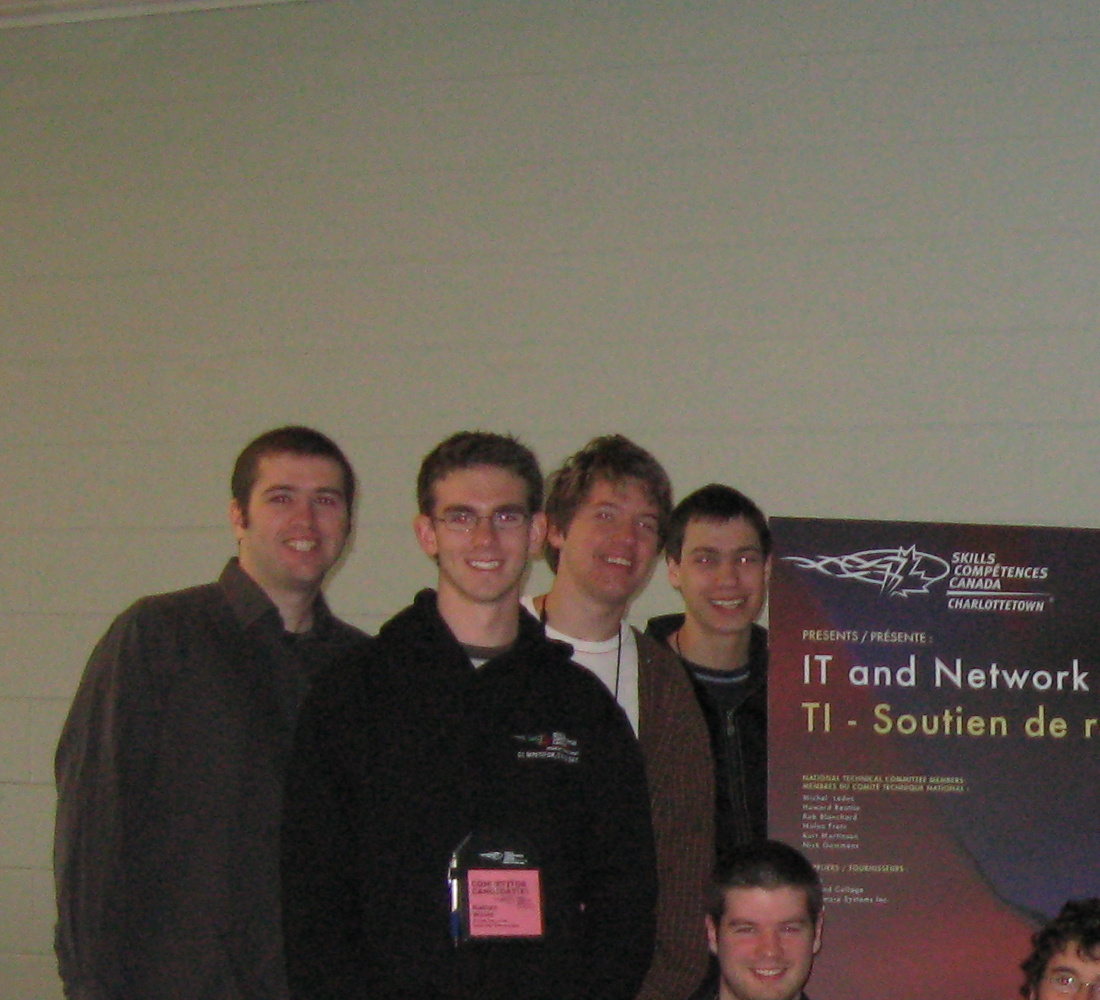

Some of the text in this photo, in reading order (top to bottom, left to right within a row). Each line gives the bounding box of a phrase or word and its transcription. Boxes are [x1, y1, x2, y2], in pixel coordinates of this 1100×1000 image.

[951, 552, 996, 564] SKILLS
[954, 563, 1048, 579] COMPÉTENCES
[949, 578, 1001, 590] CANADA
[947, 598, 1045, 612] CHARLOTTETOWN
[802, 629, 858, 641] PRESENTS
[870, 629, 926, 643] PRÉSENTE
[803, 654, 833, 685] IT
[849, 654, 916, 687] and
[935, 656, 1090, 692] Network
[801, 702, 831, 733] TI
[873, 703, 1008, 736] Soutien
[1024, 704, 1068, 739] de
[802, 774, 839, 782] NATIONAL
[885, 775, 927, 783] COMMITTEE
[929, 776, 964, 784] MEMBERS
